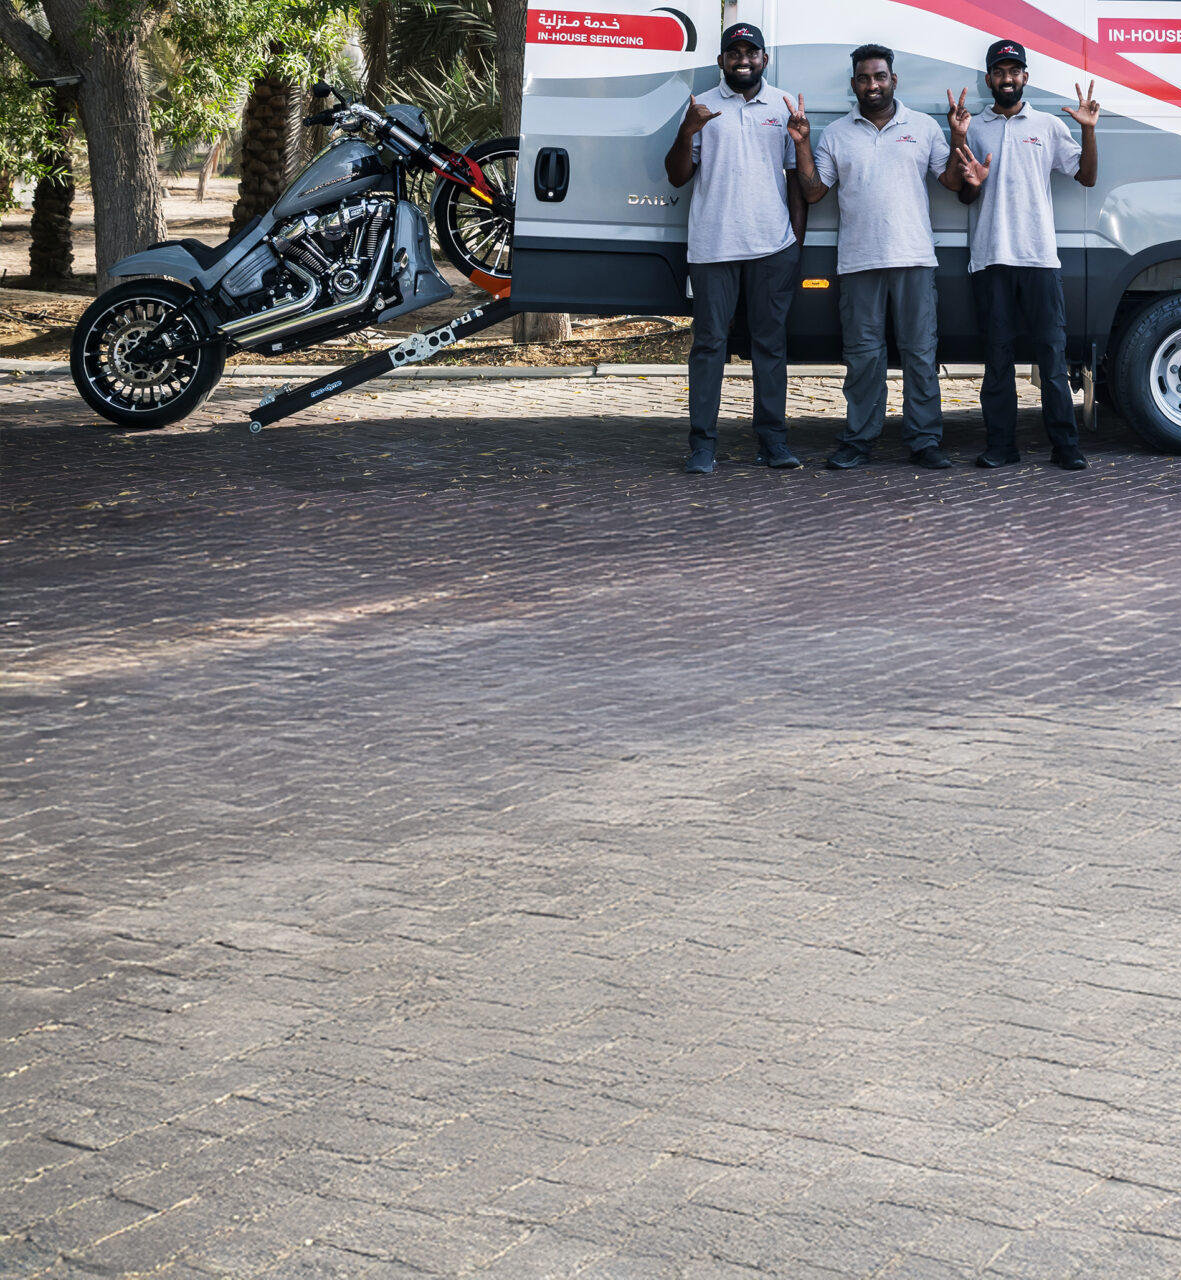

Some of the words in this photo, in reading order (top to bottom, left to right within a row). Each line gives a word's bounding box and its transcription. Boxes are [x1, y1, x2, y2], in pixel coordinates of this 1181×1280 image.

[537, 13, 581, 30] منزلية
[583, 16, 621, 30] خدمة
[537, 32, 588, 43] IN-HOUSE
[590, 34, 644, 46] SERVICING
[627, 194, 680, 207] DAILY
